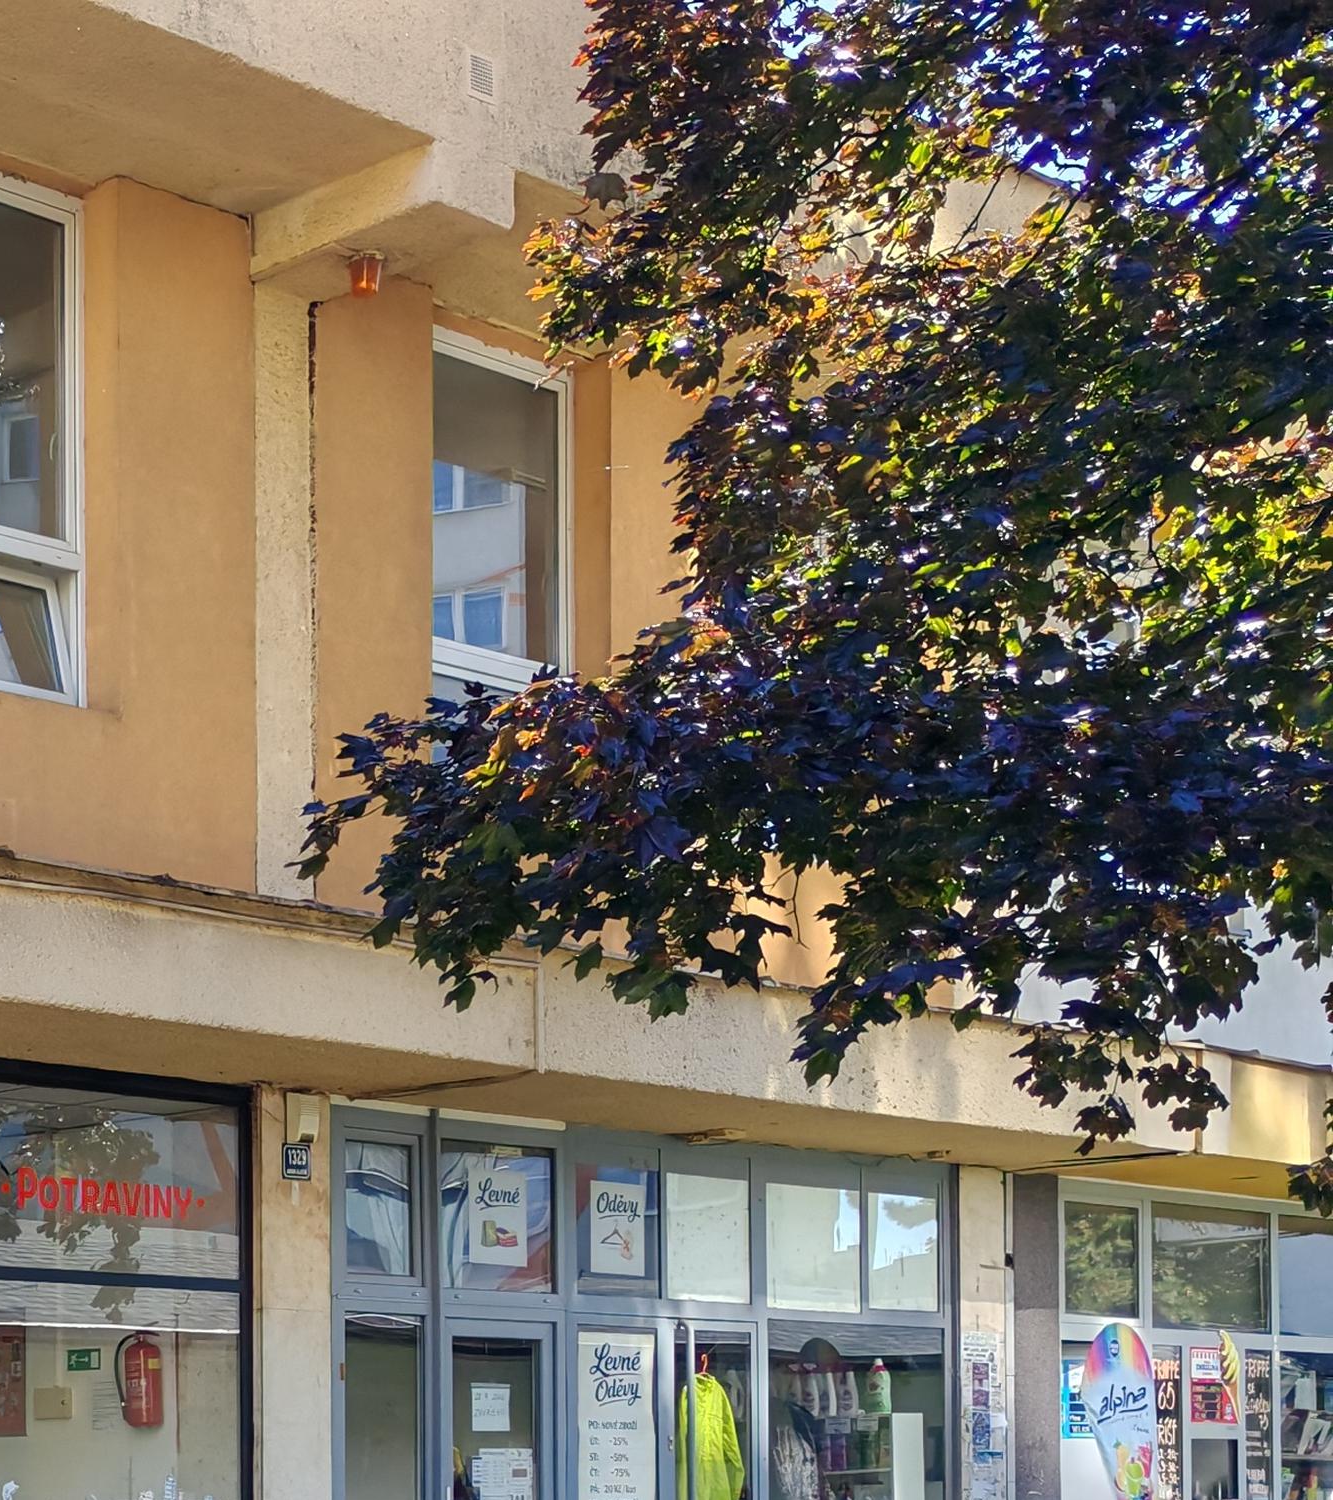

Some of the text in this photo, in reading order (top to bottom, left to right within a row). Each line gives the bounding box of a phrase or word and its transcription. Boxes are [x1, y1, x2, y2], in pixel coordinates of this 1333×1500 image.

[287, 1148, 307, 1166] 1329
[16, 1165, 193, 1220] POTRAVINY
[475, 1177, 521, 1210] Levné
[596, 1191, 641, 1222] Oděvy
[589, 1342, 642, 1377] Levné
[595, 1378, 642, 1406] Oděvy
[1099, 1383, 1147, 1417] alpina
